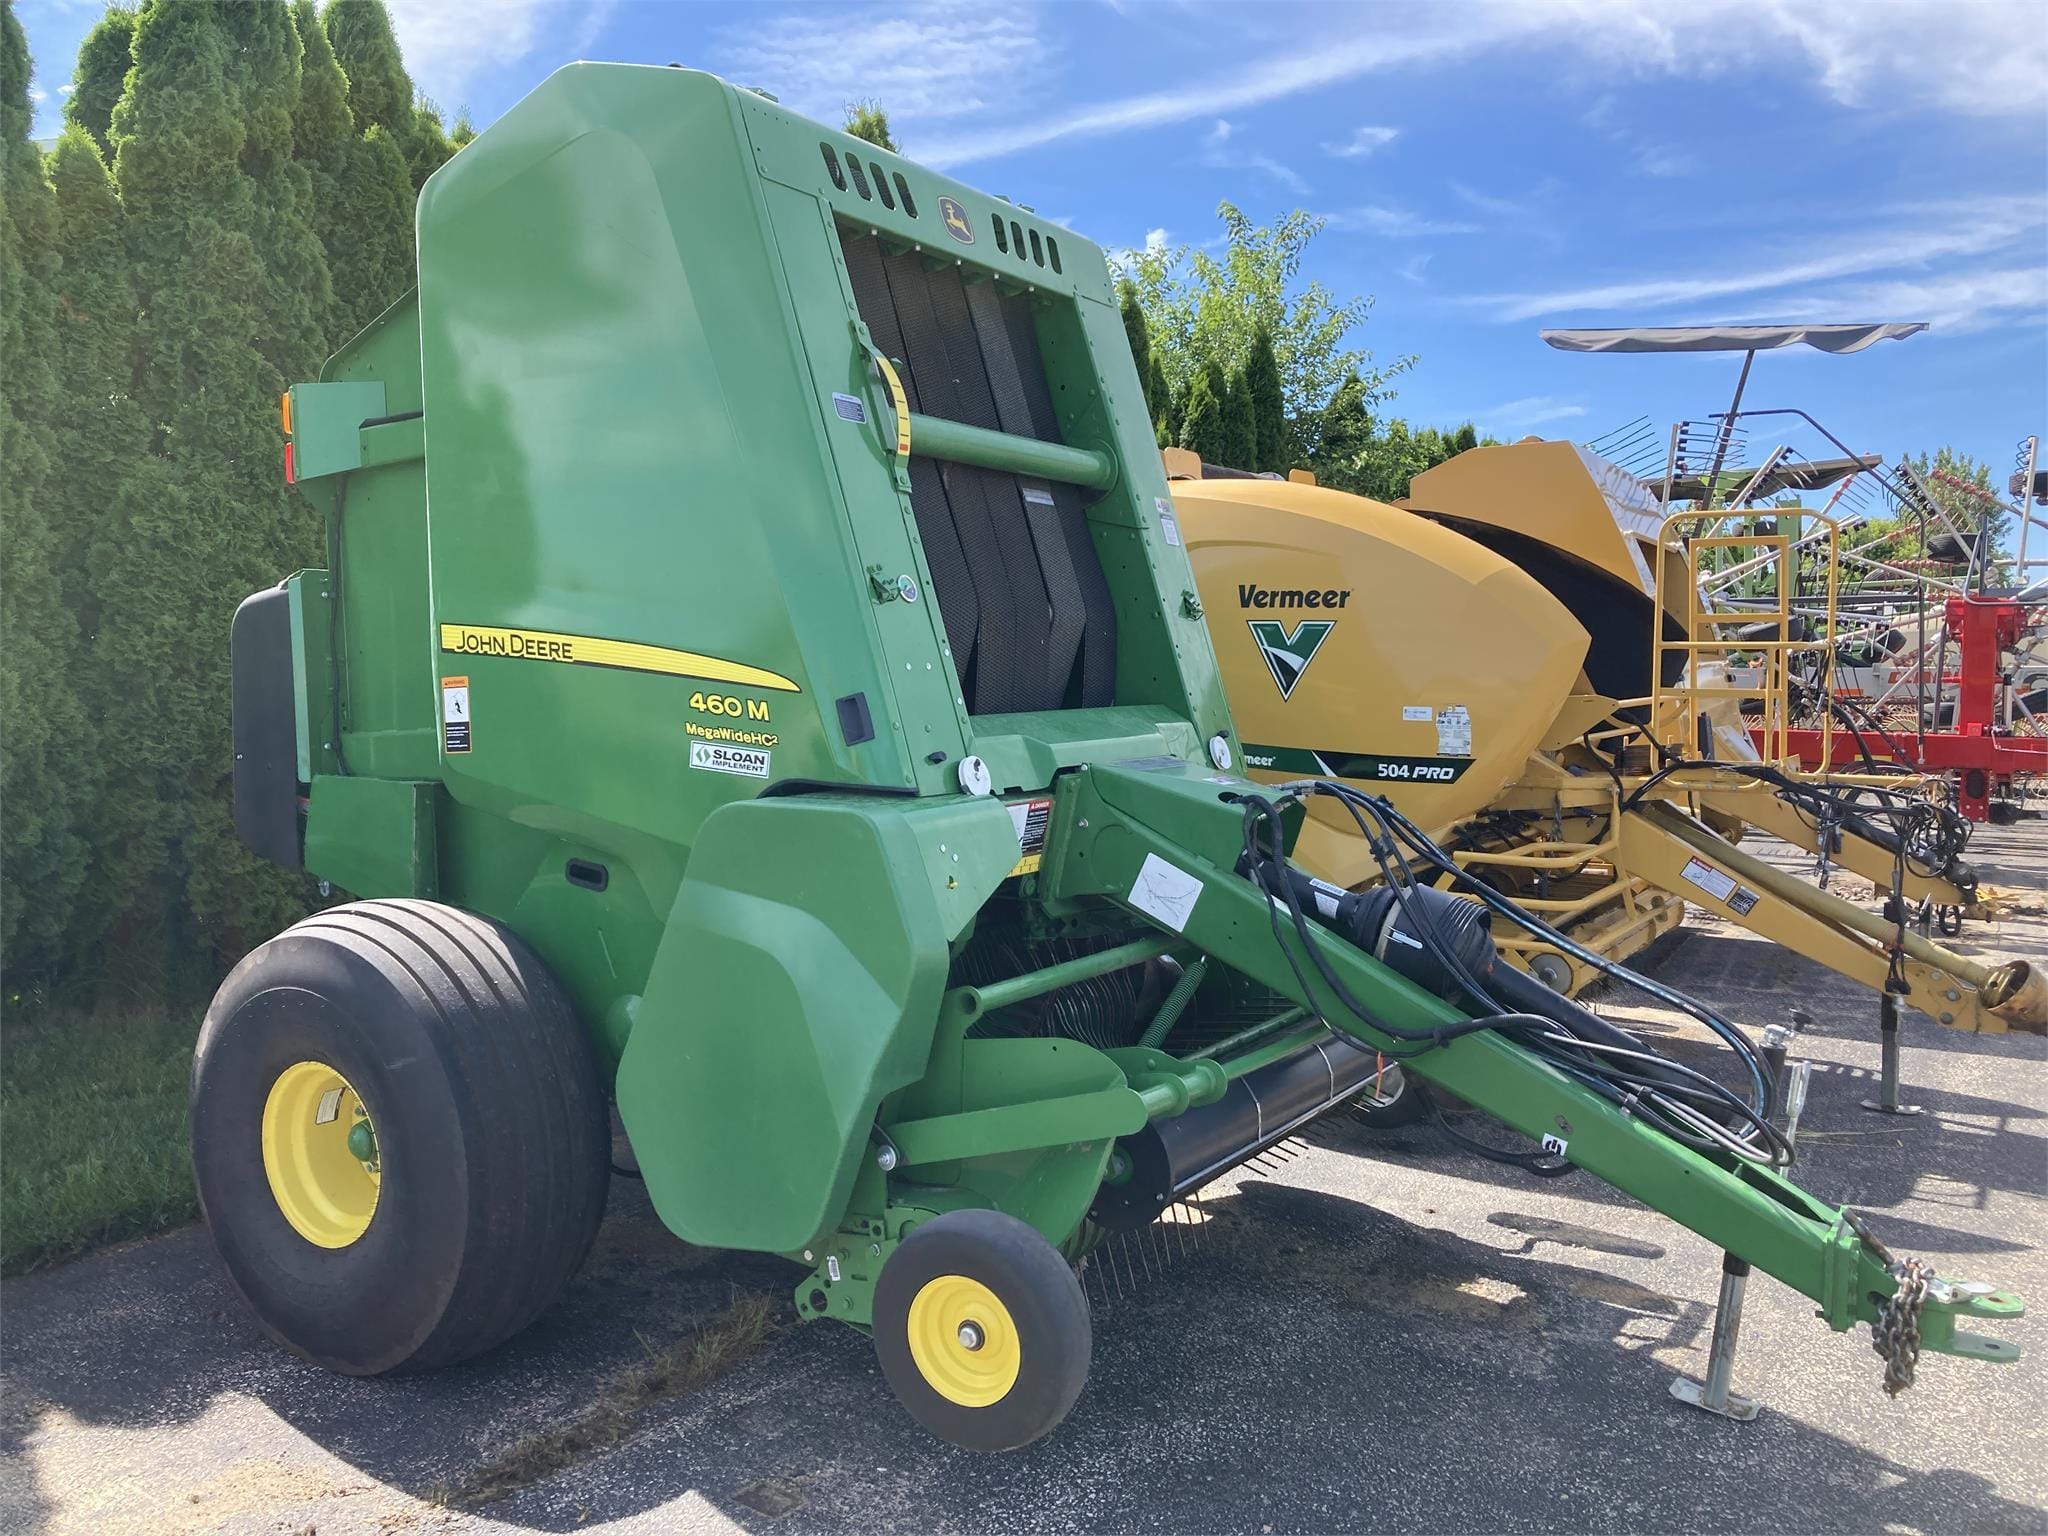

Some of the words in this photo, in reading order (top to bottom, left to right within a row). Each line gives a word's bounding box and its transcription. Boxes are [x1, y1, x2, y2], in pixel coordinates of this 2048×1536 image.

[1238, 584, 1350, 608] Vermeer
[456, 631, 505, 653] JOHN
[510, 634, 573, 660] DEERE
[689, 691, 743, 718] 460
[746, 699, 770, 722] M
[712, 749, 765, 765] SLOAN
[1244, 755, 1273, 767] meer
[712, 759, 765, 773] IMPLEMENT
[1378, 763, 1410, 778] 504
[1412, 766, 1455, 780] PRO
